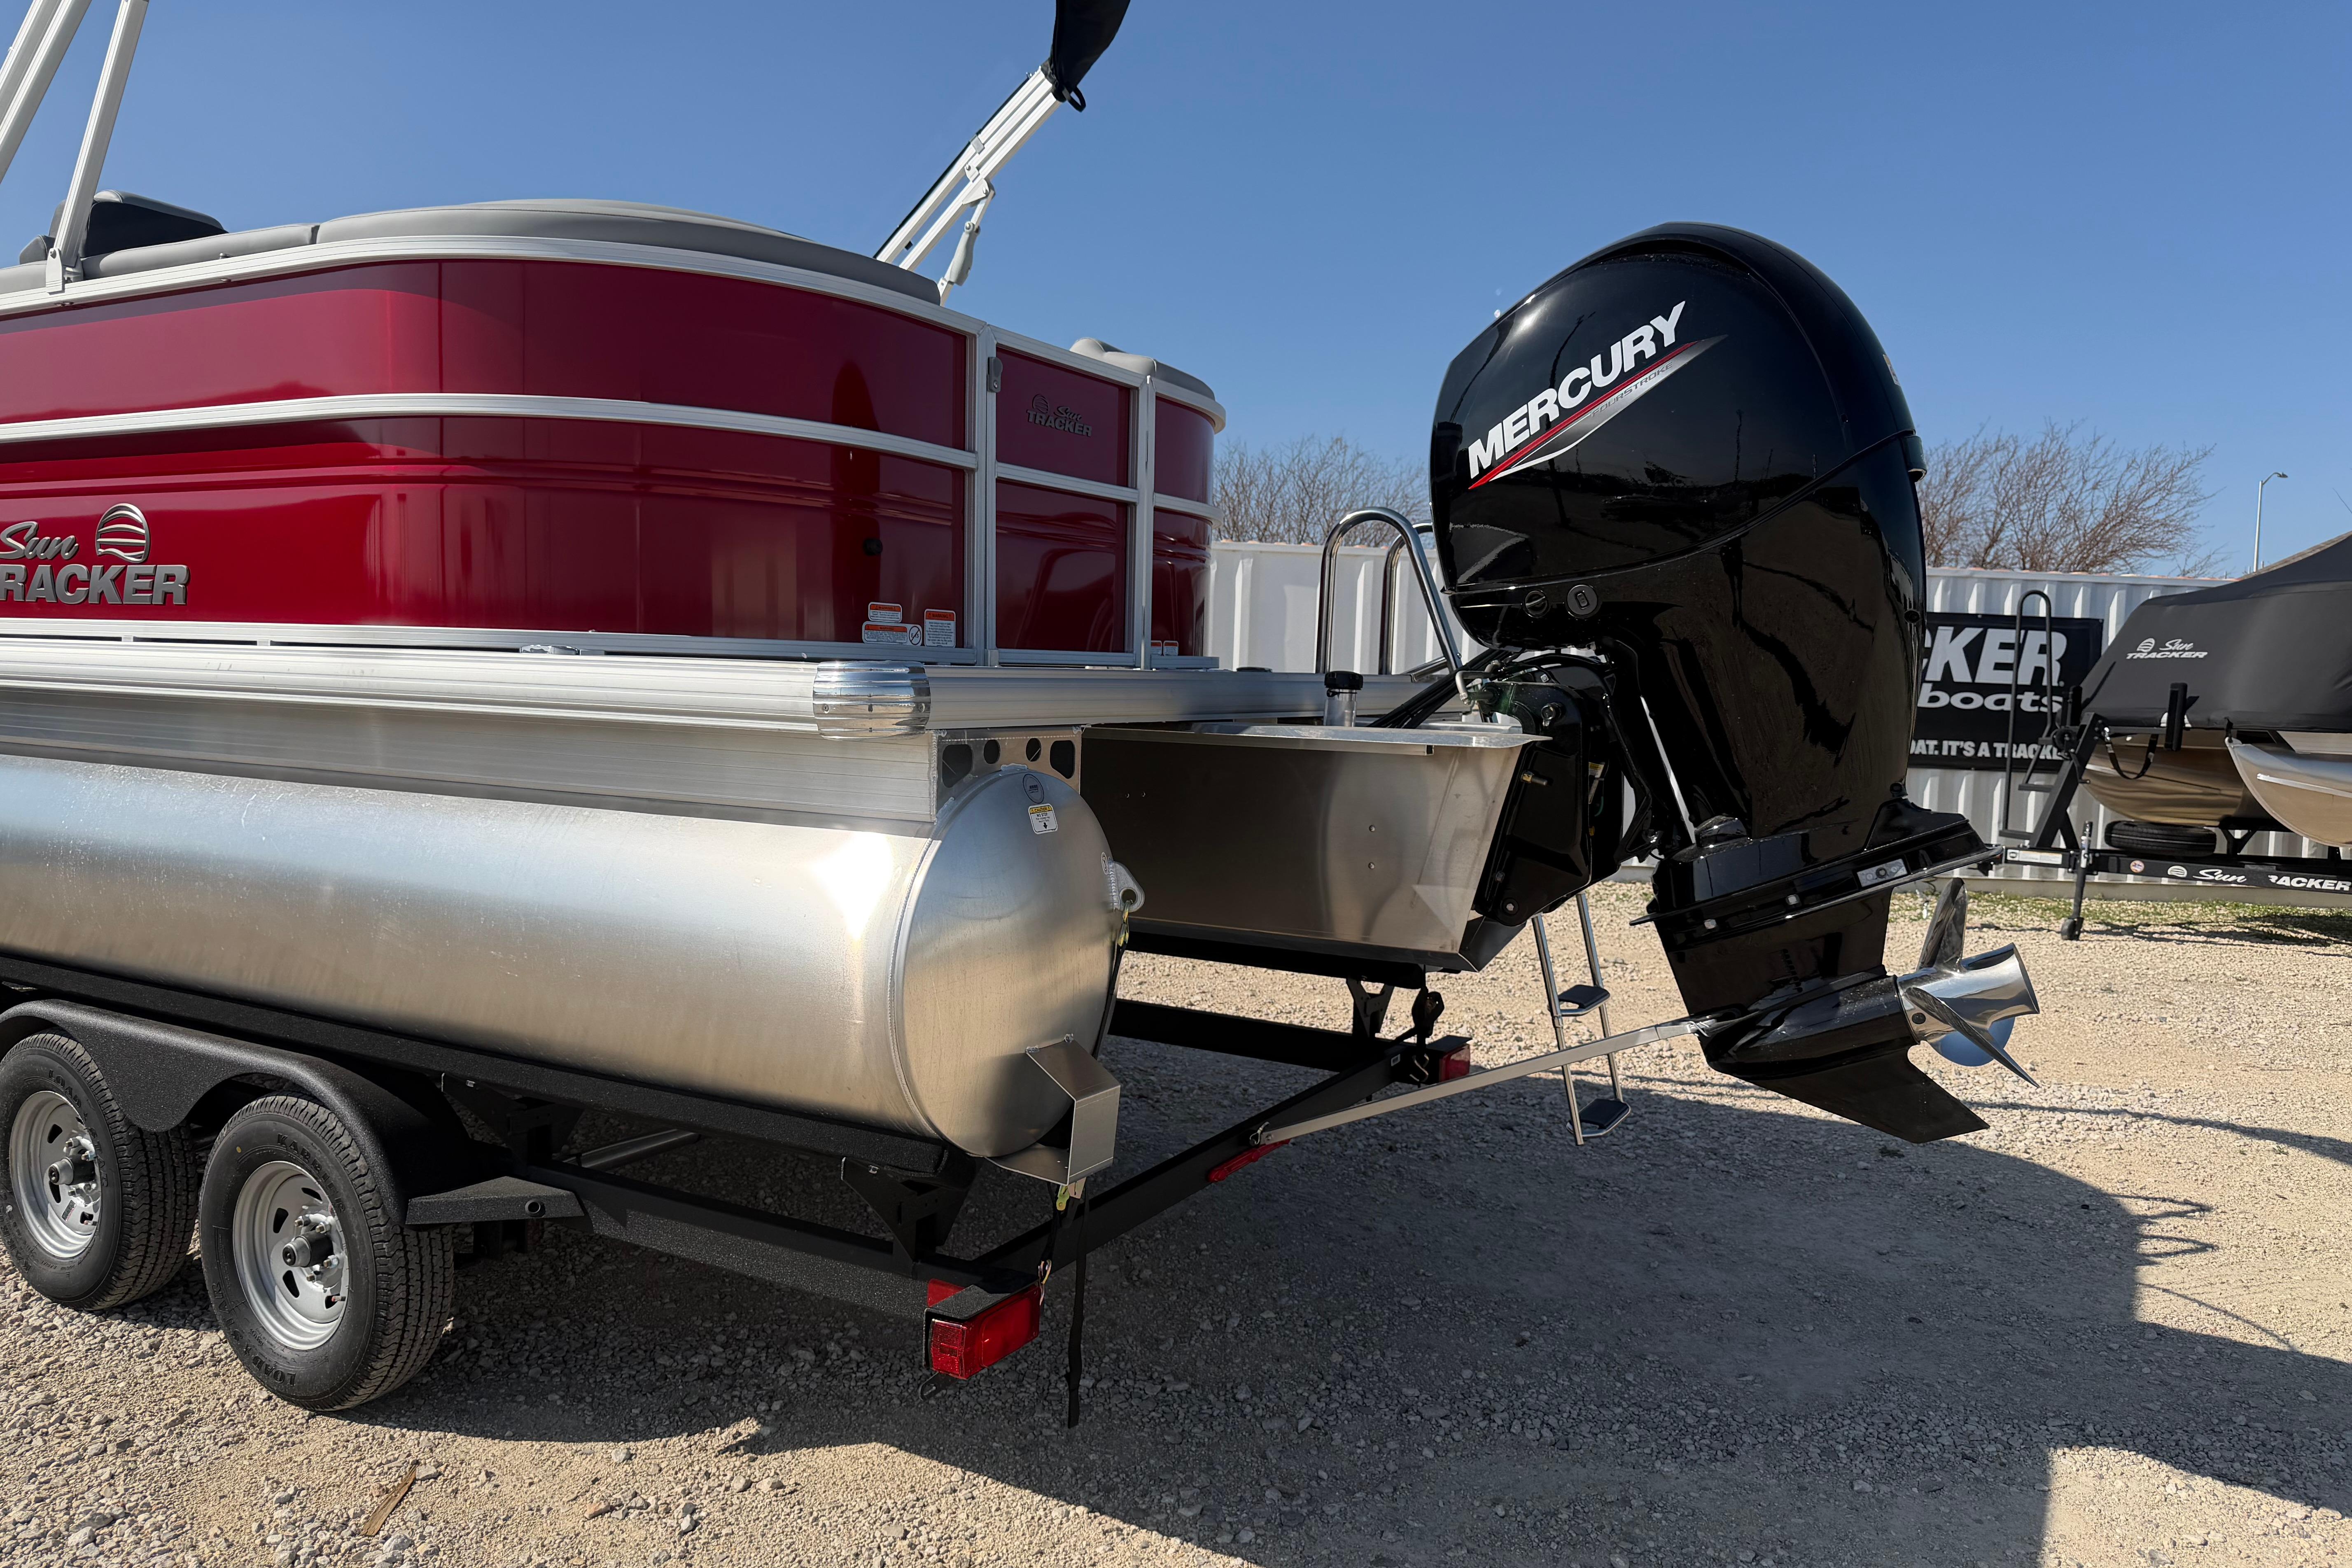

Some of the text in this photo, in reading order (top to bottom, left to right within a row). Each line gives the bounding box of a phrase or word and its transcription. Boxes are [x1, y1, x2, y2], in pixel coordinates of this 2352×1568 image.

[1468, 301, 1685, 478] MERCURY
[1591, 362, 1673, 417] FOURSTROKE
[1027, 410, 1092, 437] TRACKER
[1054, 406, 1083, 421] Sun
[0, 521, 79, 560] Sun
[2159, 639, 2193, 651] Sun
[1917, 683, 2063, 713] boats
[1942, 740, 1975, 757] IT'S
[1977, 742, 1990, 758] A
[2193, 869, 2247, 882] Sun
[278, 1133, 346, 1213] KARRIER
